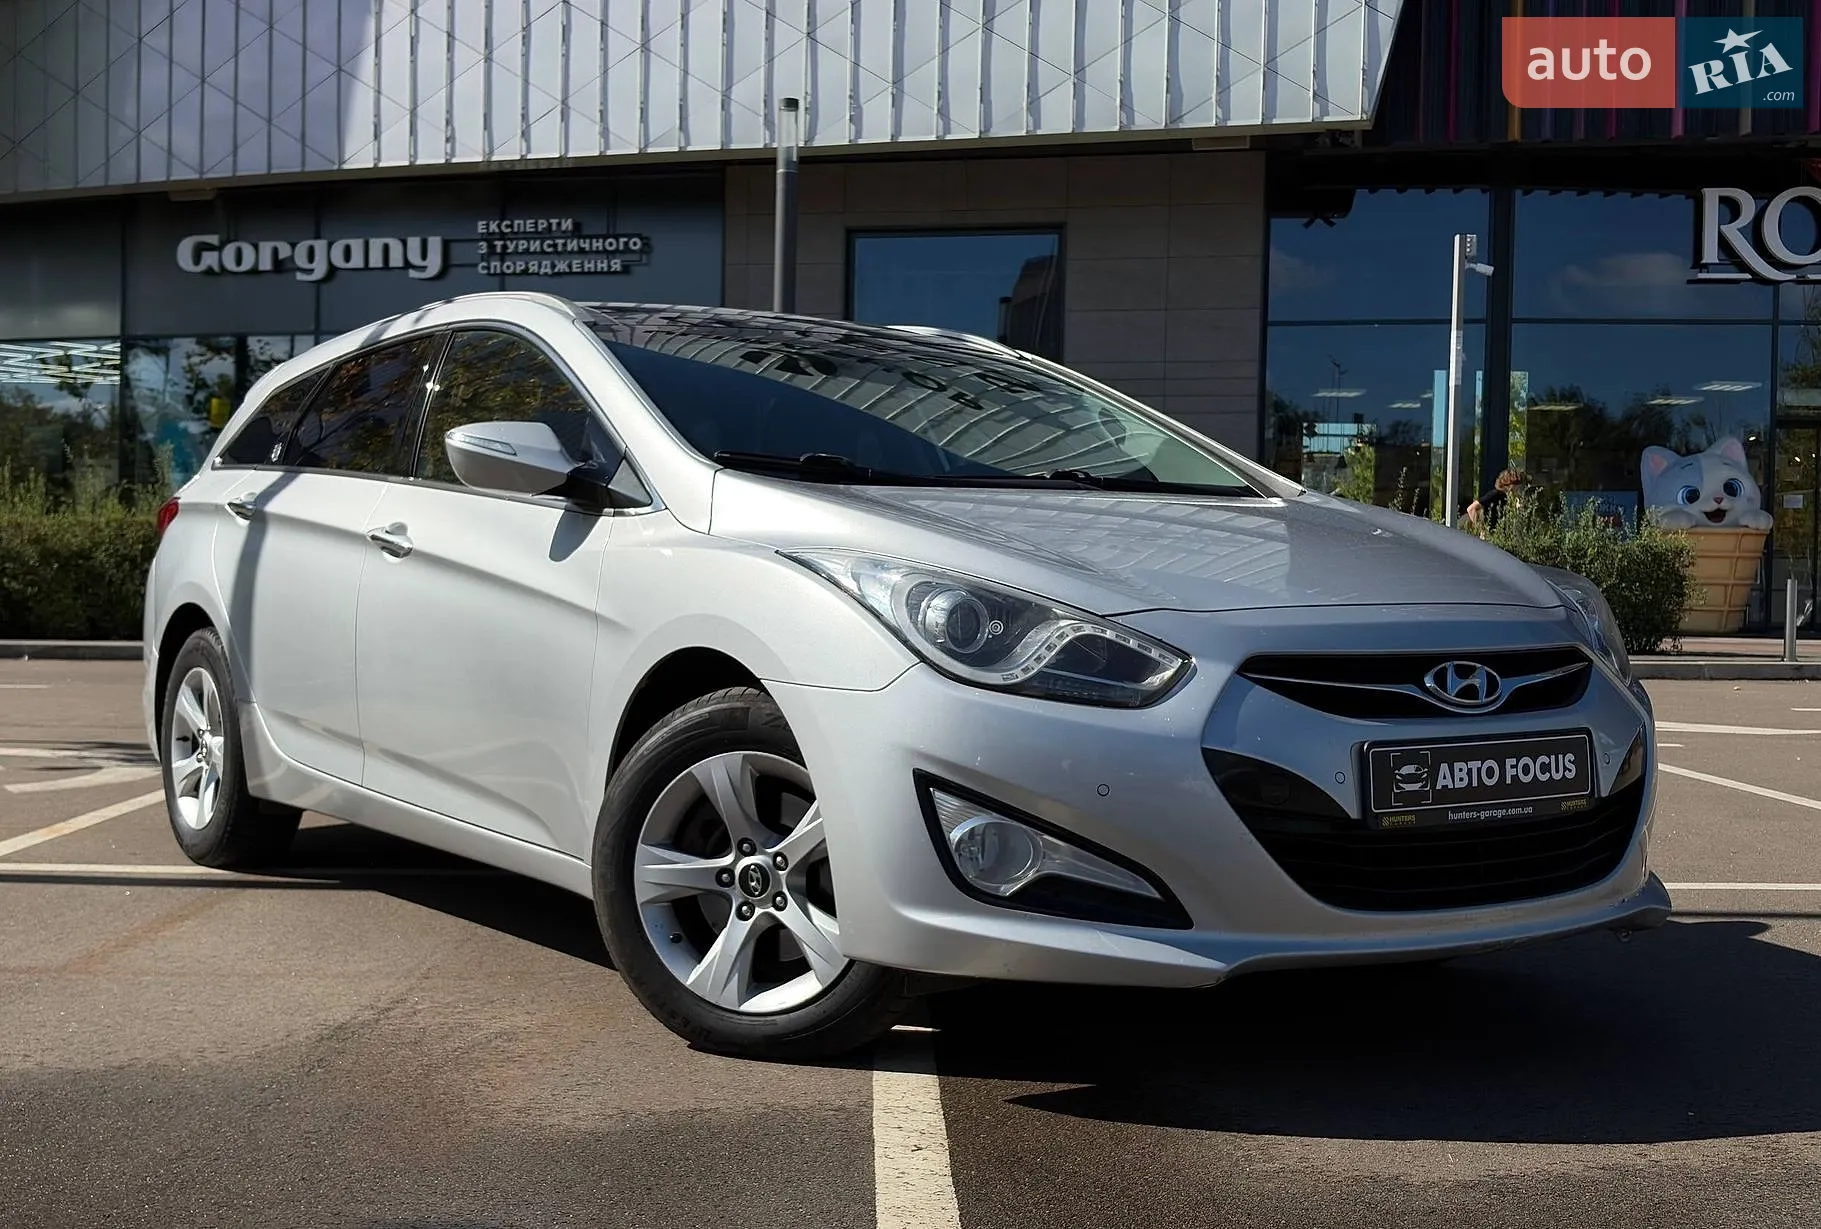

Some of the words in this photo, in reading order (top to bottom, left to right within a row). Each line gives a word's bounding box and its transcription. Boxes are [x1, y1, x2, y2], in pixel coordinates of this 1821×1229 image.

[477, 218, 574, 234] ЕКСПЕРТИ
[477, 241, 488, 254] З
[494, 237, 642, 254] ТУРИСТИЧНОГО
[176, 234, 443, 281] Gorgany
[477, 259, 622, 275] СПОРЯДЖЕННЯ
[1436, 759, 1499, 790] АВТО
[1505, 753, 1576, 784] FOCUS
[1448, 806, 1533, 820] hunters-garage.com.ua
